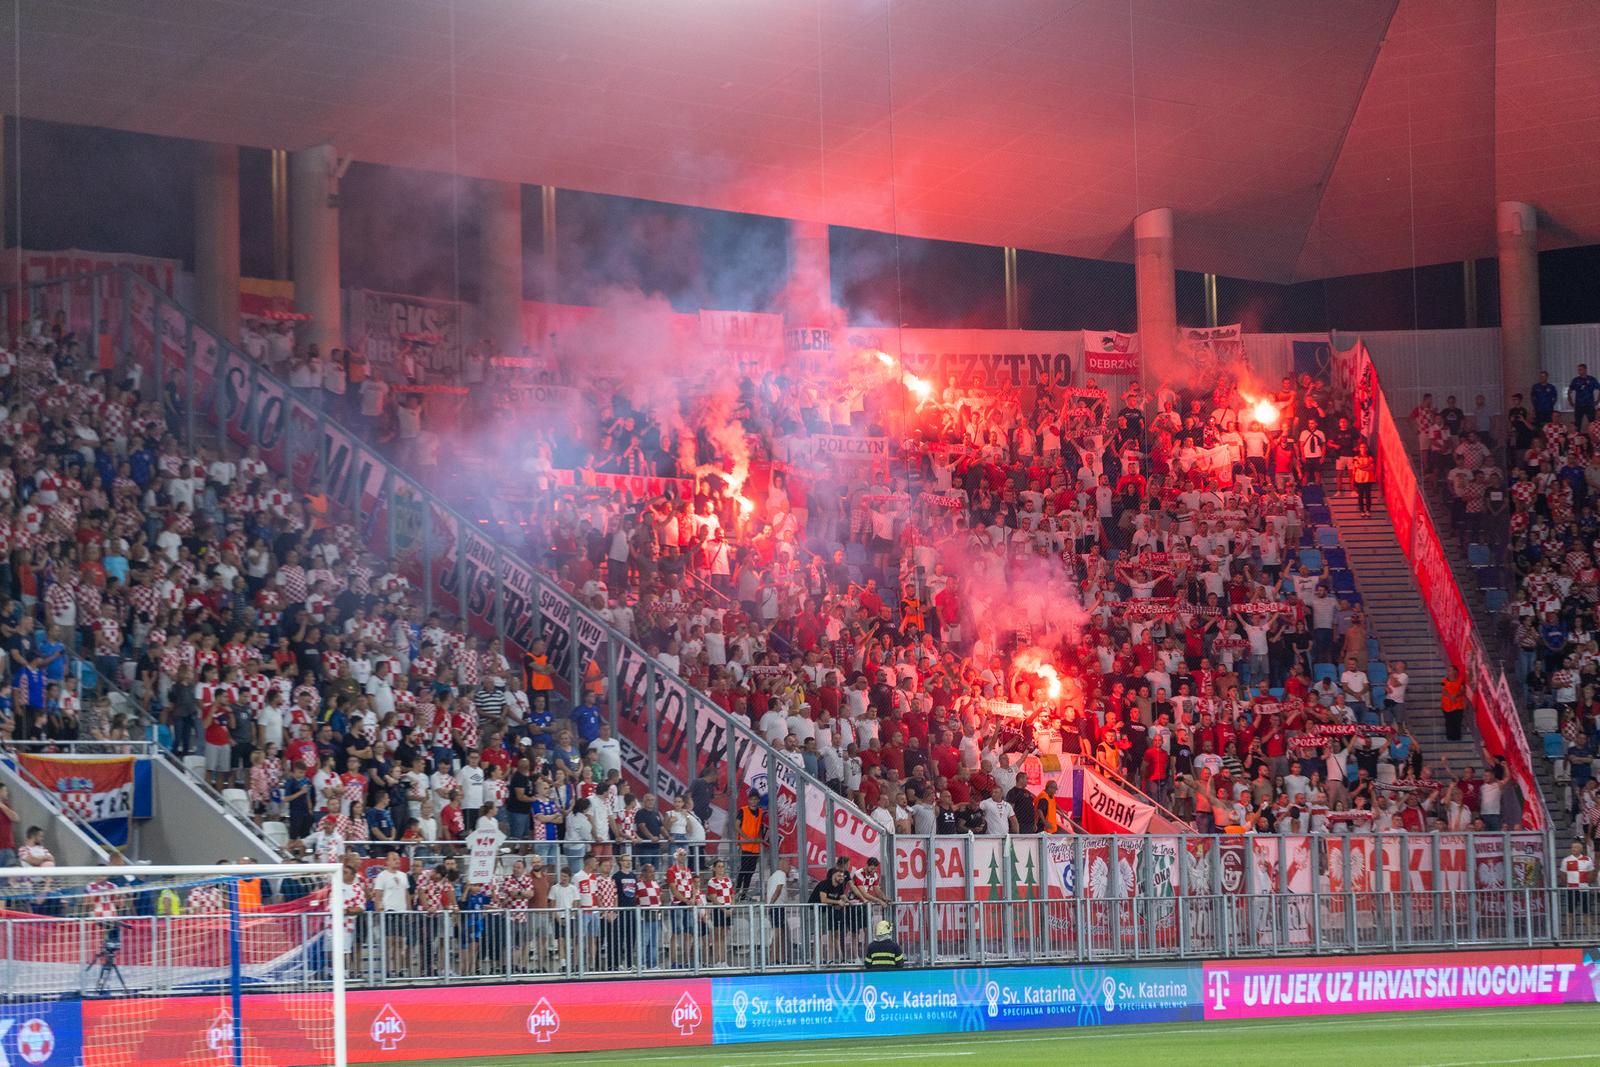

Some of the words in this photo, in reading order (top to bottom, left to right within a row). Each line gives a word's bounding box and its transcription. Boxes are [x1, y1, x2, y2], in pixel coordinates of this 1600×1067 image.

[1089, 783, 1137, 828] ŻAGAŃ
[1003, 986, 1020, 1005] Sv.
[1025, 984, 1076, 1003] Katarina
[1119, 982, 1136, 999] Sv.
[1139, 980, 1188, 999] Katarina
[1243, 972, 1322, 1006] UVIJEK
[1325, 971, 1353, 1003] UZ
[1357, 967, 1457, 1001] HRVATSKI
[1462, 963, 1576, 996] NOGOMET
[752, 997, 771, 1015] Sv.
[776, 994, 833, 1014] Katarina
[881, 991, 899, 1009] Sv.
[903, 989, 958, 1008] Katarina
[675, 1003, 698, 1027] pik
[1003, 1006, 1044, 1016] SPECIJALNA
[1047, 1005, 1076, 1014] BOLNICA
[374, 1017, 402, 1042] pik
[530, 1009, 556, 1035] pik
